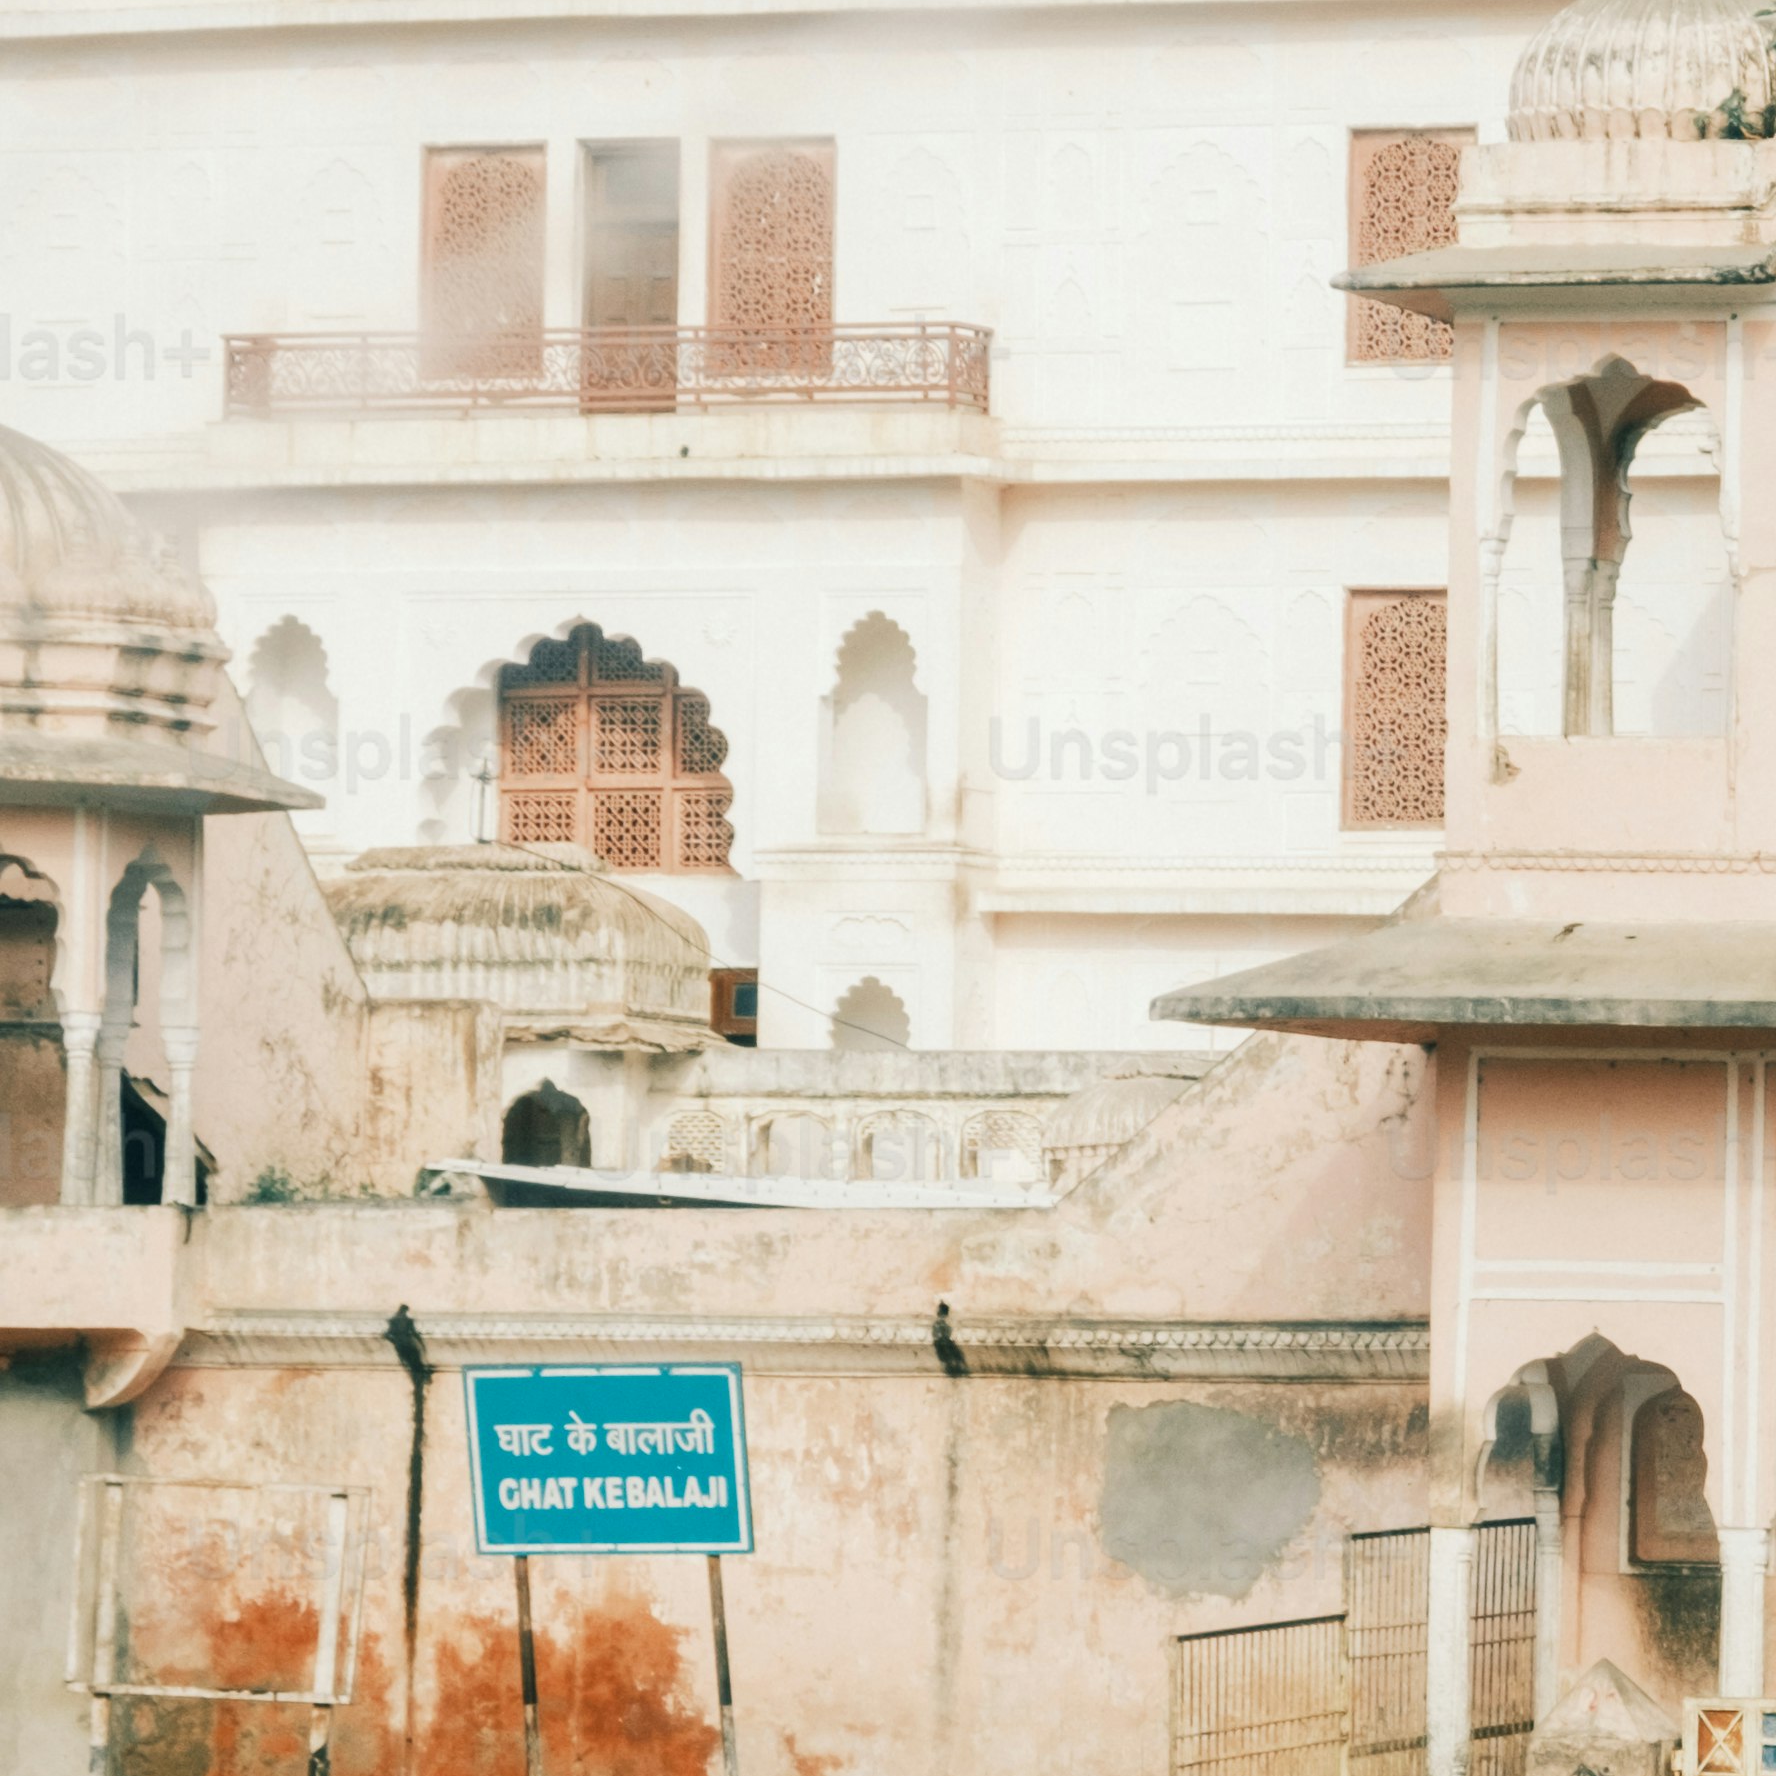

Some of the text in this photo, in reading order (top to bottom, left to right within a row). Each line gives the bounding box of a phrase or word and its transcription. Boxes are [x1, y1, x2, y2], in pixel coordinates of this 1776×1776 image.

[493, 1407, 716, 1456] घाट के बालाजी
[498, 1477, 578, 1510] GHAT
